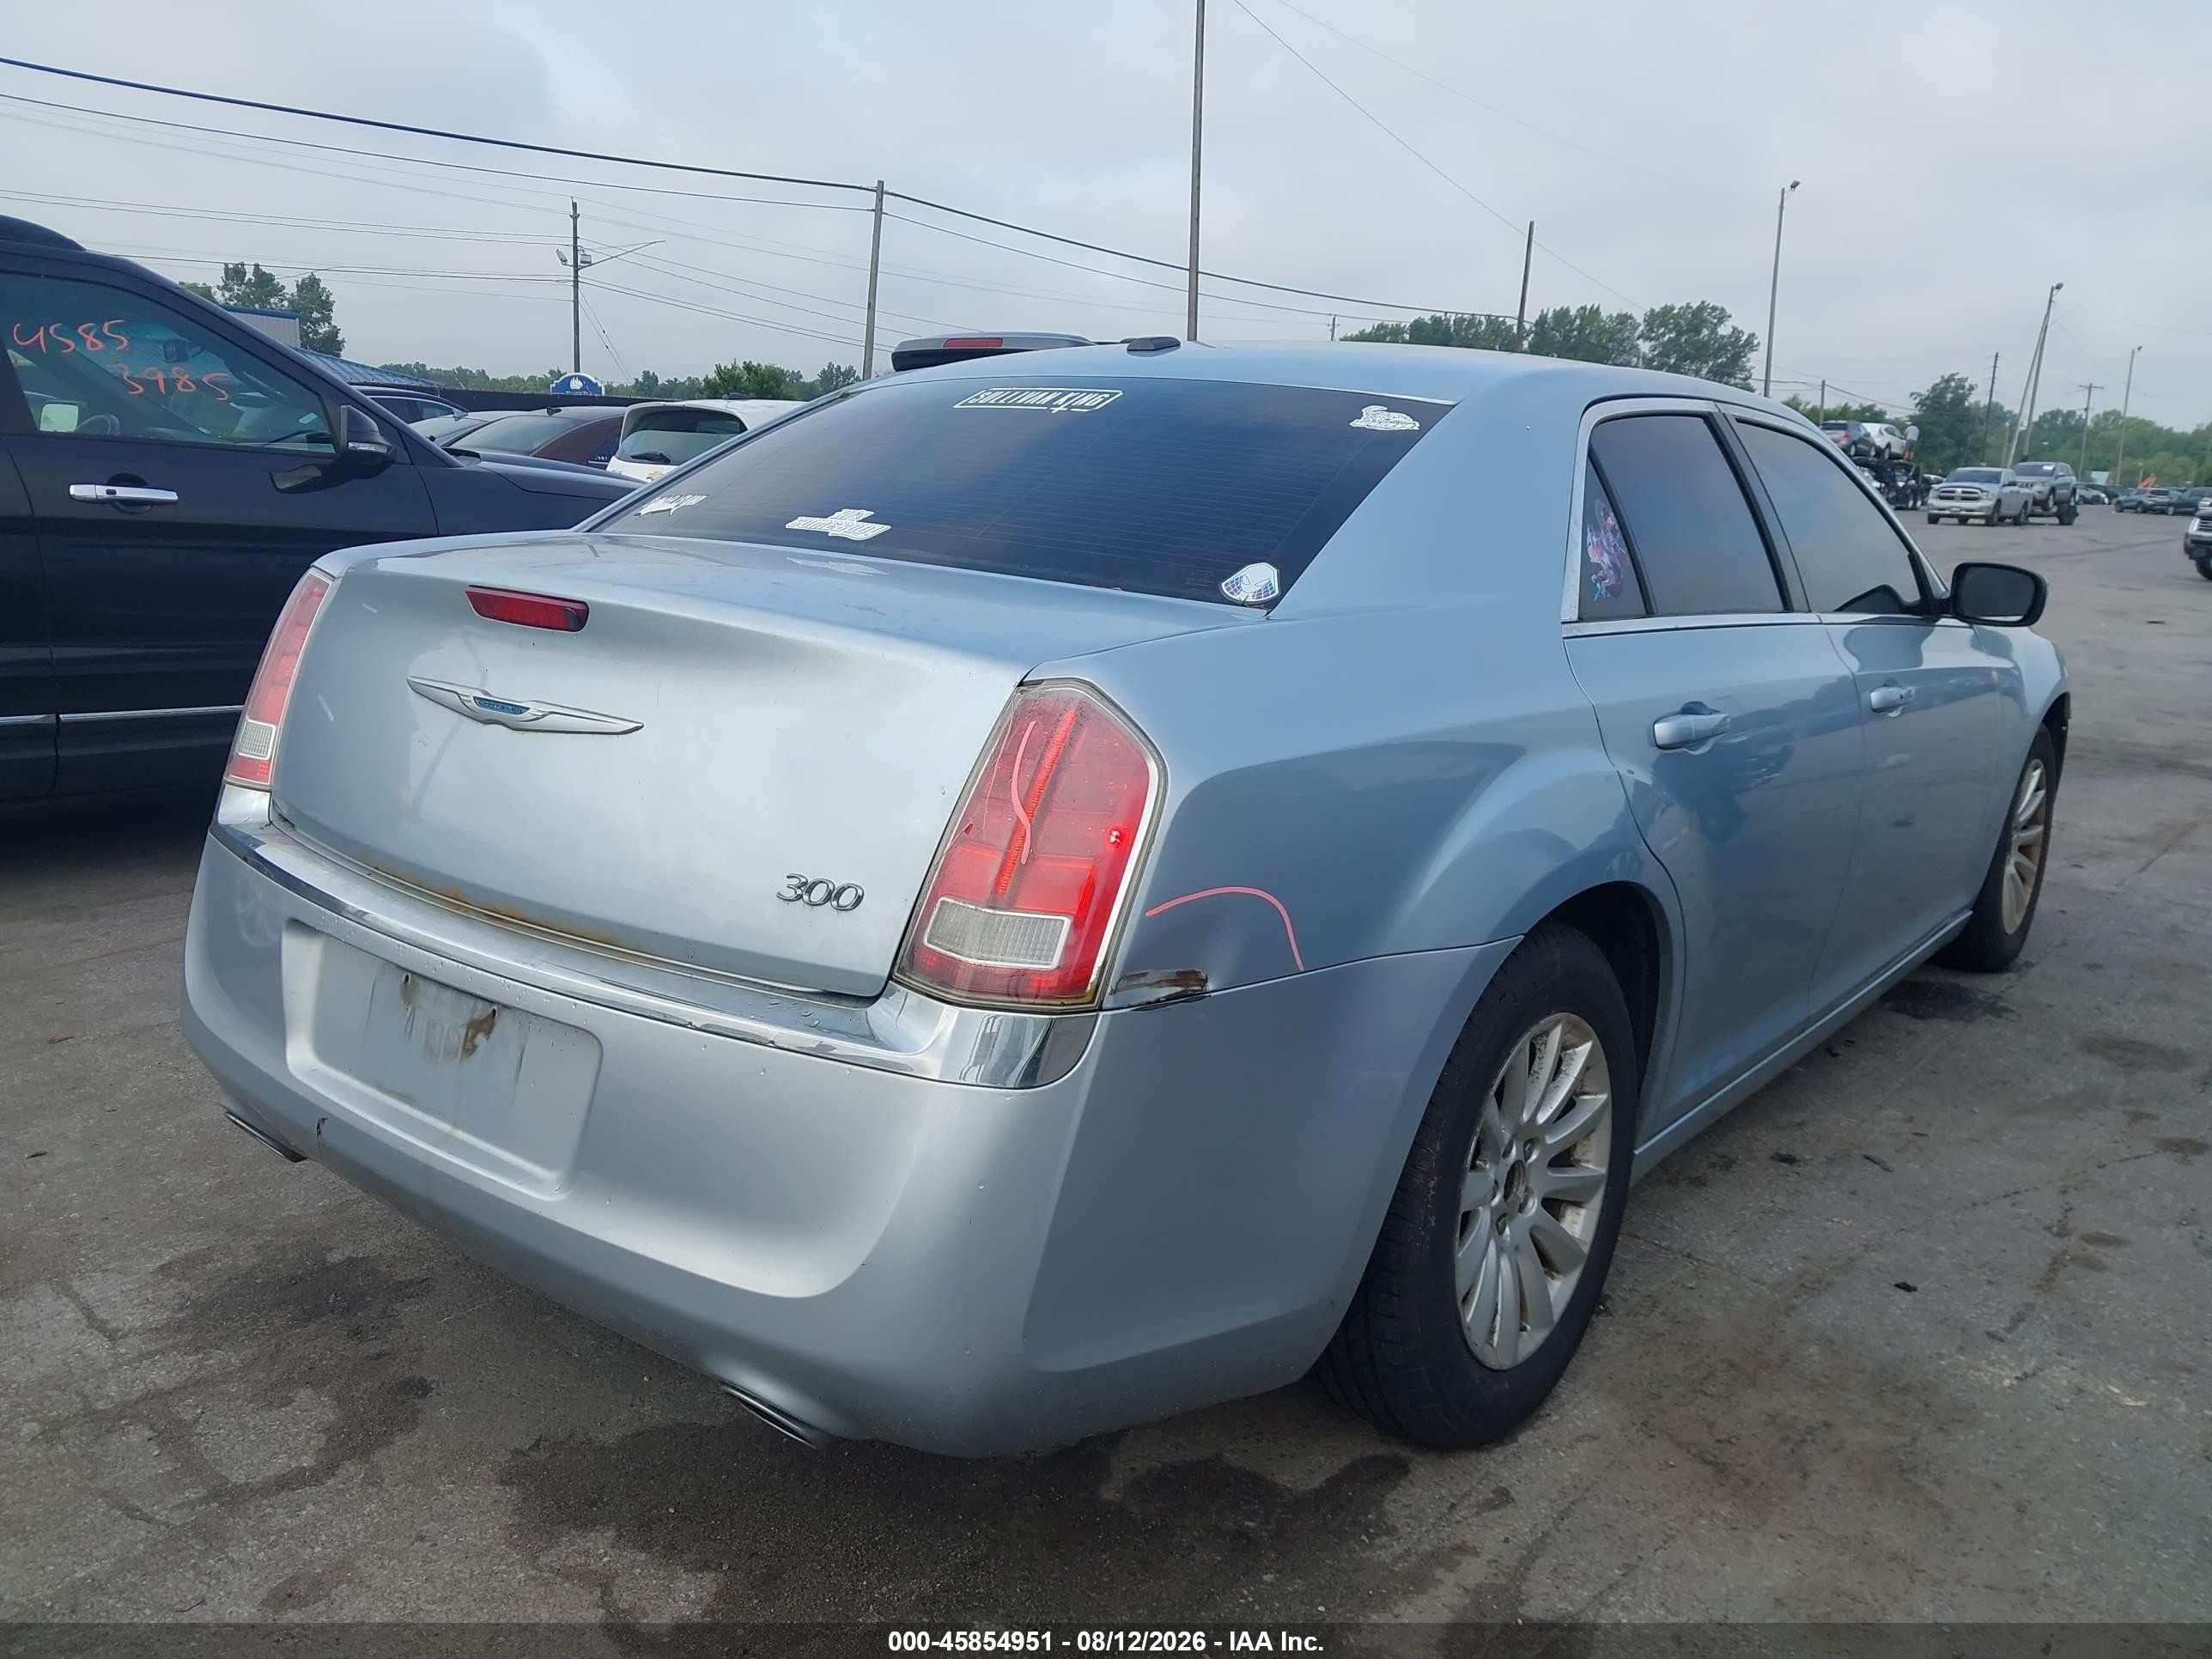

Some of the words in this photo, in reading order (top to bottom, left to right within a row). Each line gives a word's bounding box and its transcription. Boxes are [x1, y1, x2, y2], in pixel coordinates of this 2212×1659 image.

[12, 319, 131, 354] 4585
[112, 362, 230, 401] 3985
[1051, 392, 1110, 410] KING
[775, 872, 866, 912] 300
